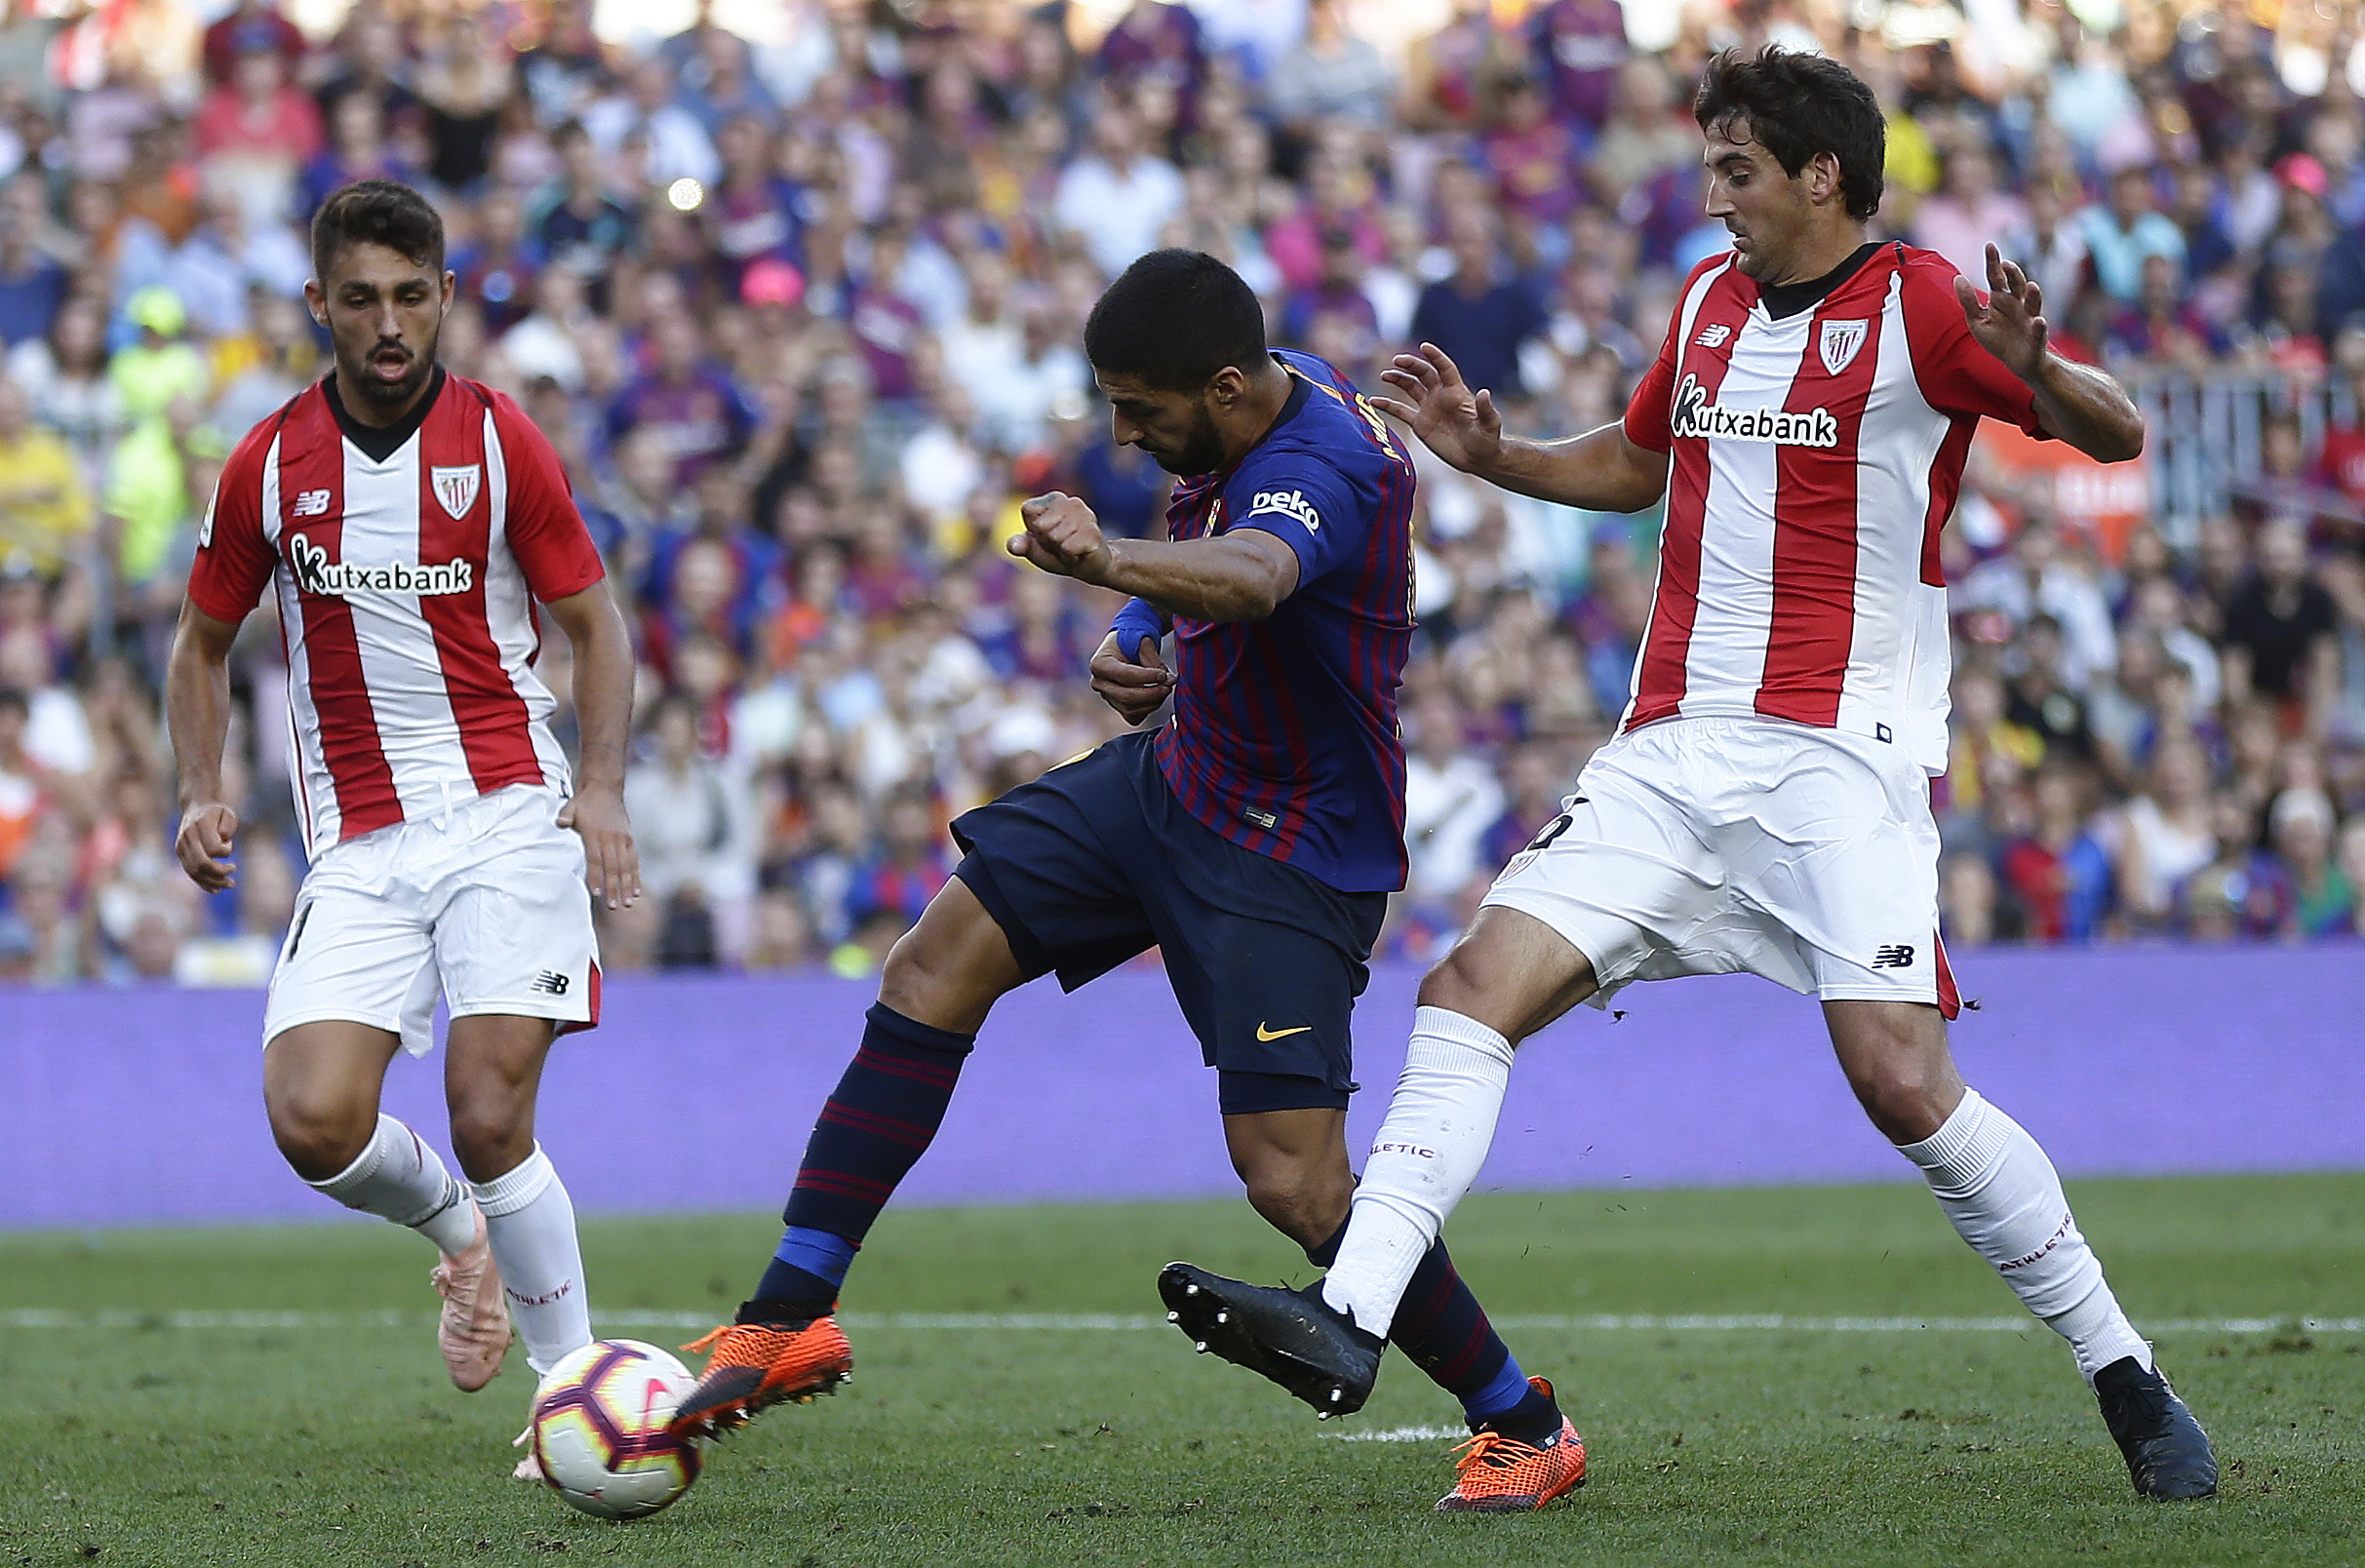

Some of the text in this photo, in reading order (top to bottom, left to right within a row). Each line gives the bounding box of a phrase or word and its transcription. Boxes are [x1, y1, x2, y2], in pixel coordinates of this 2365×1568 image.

[1672, 373, 1837, 447] Kutxabank
[1252, 489, 1320, 530] beko
[292, 534, 471, 594] Kutxabank
[1999, 1212, 2071, 1271] ATHLETIC
